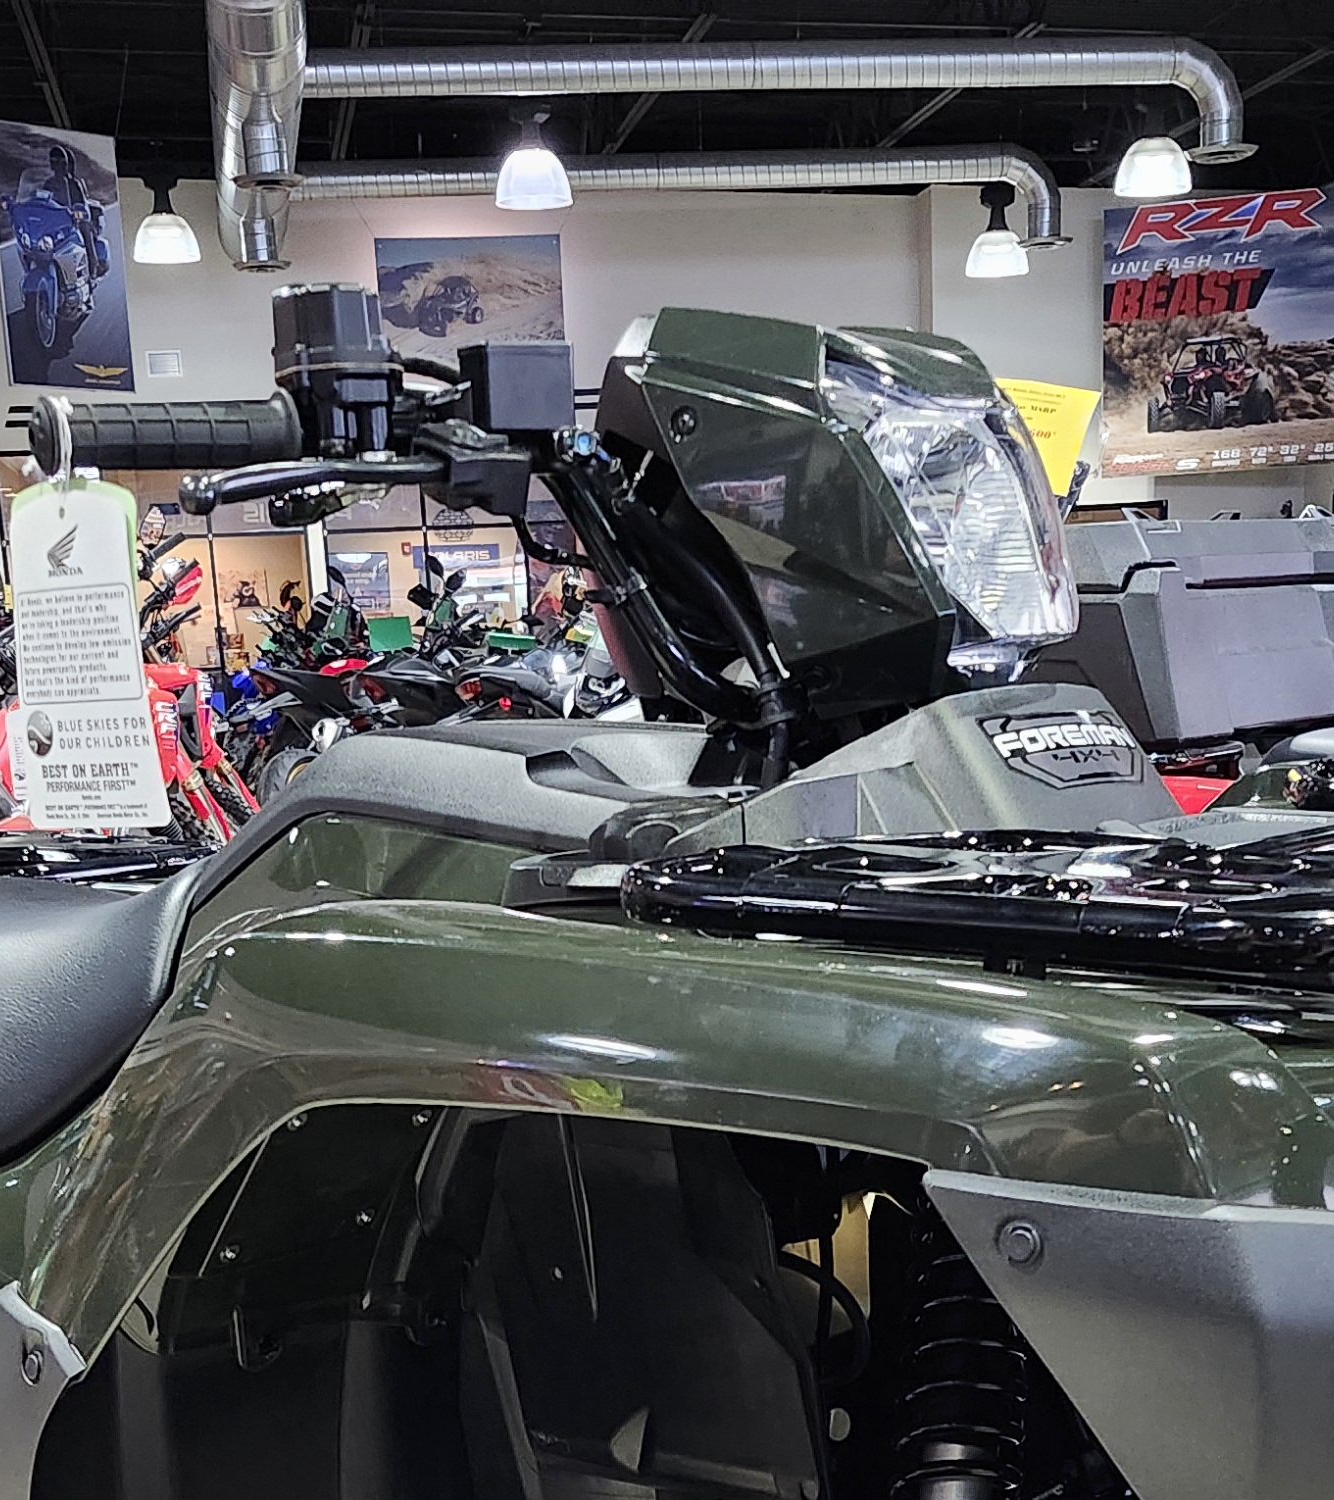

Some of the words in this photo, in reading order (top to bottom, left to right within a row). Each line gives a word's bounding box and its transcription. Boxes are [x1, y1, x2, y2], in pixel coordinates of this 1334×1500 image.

[1116, 187, 1327, 256] RZR
[1110, 254, 1212, 275] UNLEASH
[1222, 250, 1262, 266] THE
[1109, 267, 1262, 323] BEAST
[48, 566, 84, 578] HONDA
[58, 720, 83, 732] BLUE
[87, 718, 119, 730] SKIES
[123, 717, 147, 729] FOR
[59, 737, 82, 749] OUR
[86, 735, 150, 748] CHILDREN
[993, 724, 1136, 759] FOREMAN
[42, 764, 68, 778] BEST
[72, 763, 87, 778] ON
[46, 780, 101, 792] PERFORMANCE
